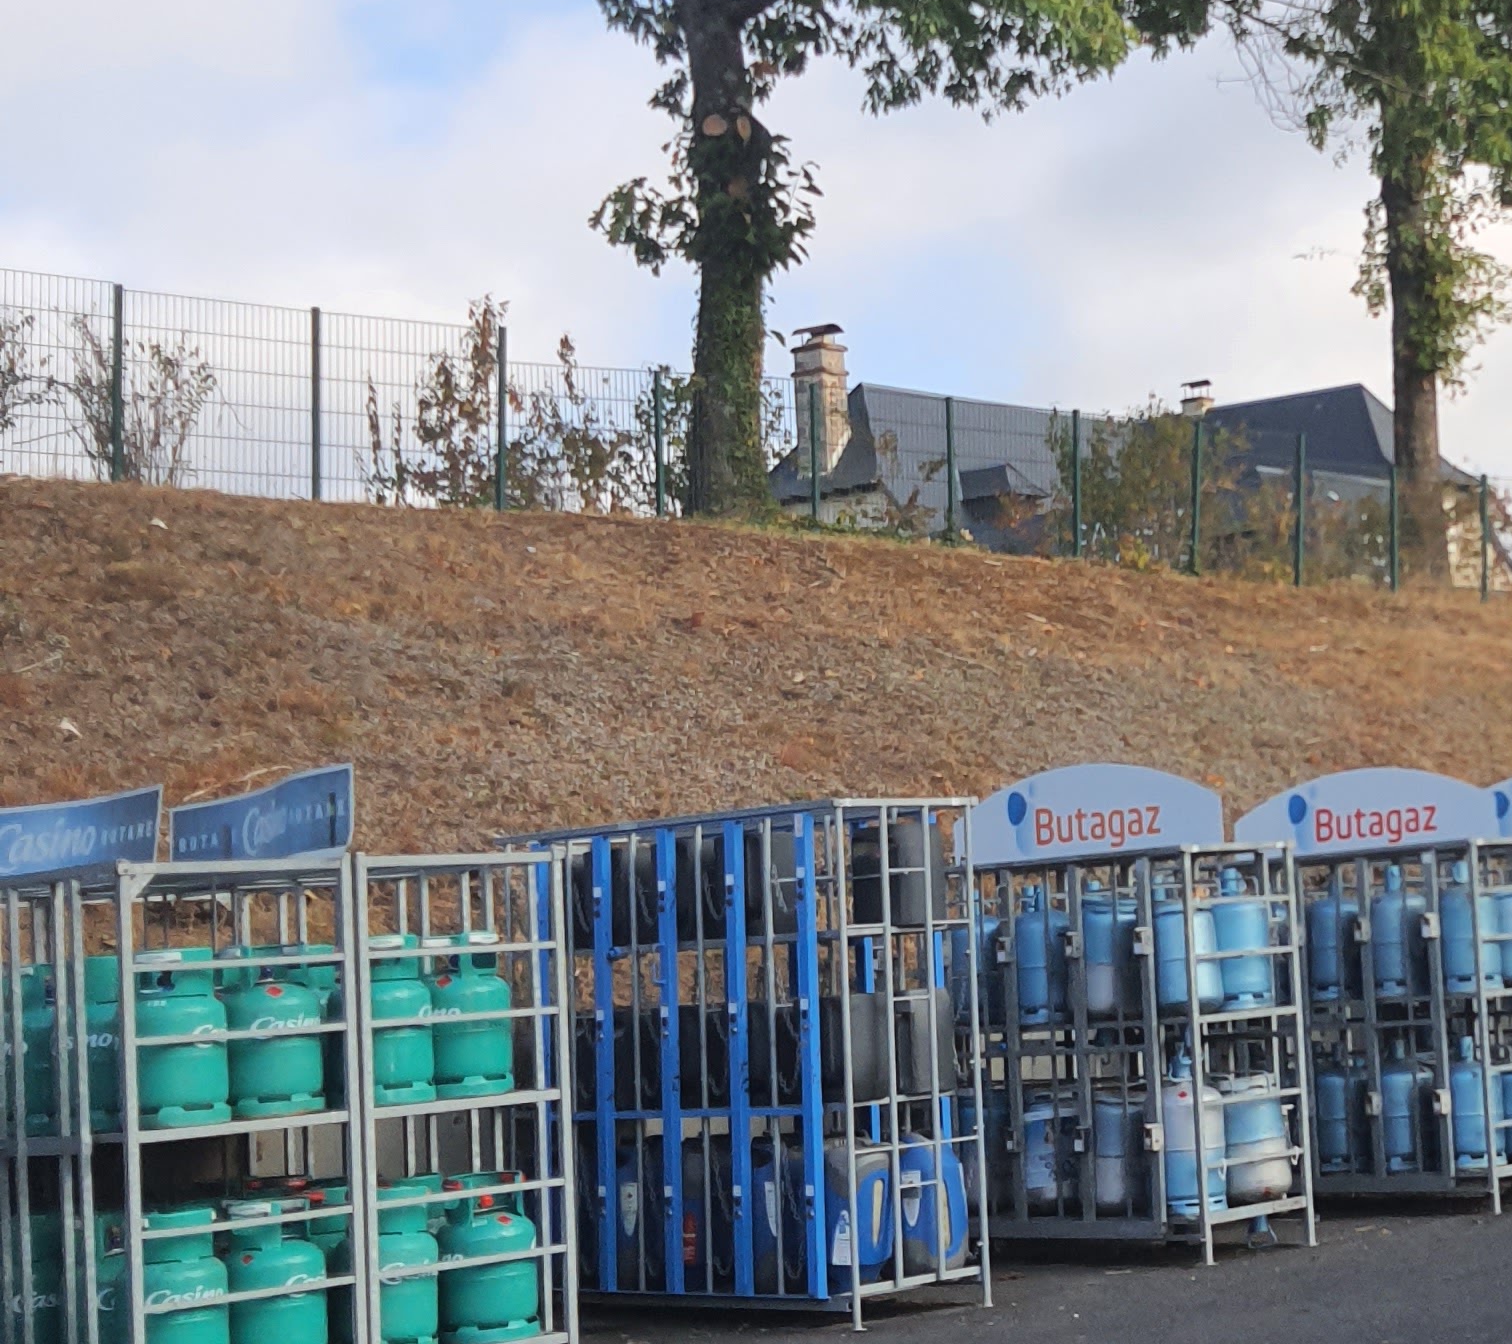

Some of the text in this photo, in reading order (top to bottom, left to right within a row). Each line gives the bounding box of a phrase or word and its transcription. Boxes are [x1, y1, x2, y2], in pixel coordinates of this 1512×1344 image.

[1035, 806, 1162, 848] Butagaz
[1314, 805, 1437, 843] Butagaz
[0, 816, 97, 875] Casino
